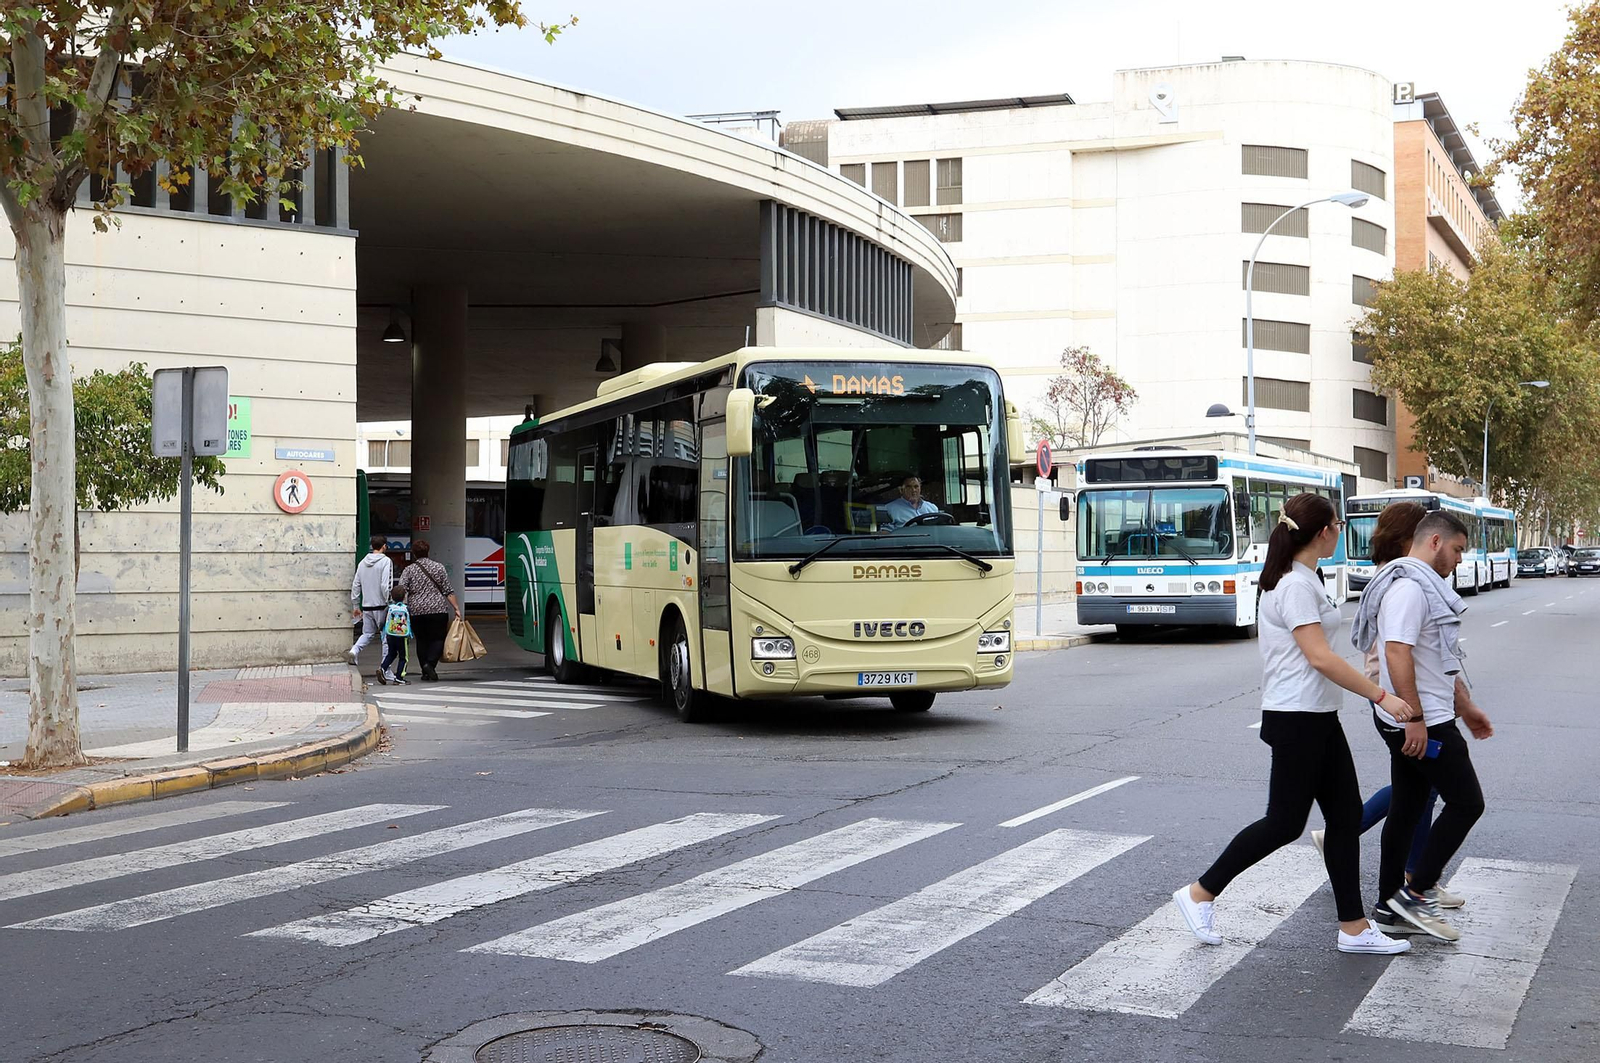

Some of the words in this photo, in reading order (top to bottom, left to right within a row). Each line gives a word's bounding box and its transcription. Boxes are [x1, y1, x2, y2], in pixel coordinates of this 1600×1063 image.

[832, 374, 904, 396] DAMAS
[286, 450, 325, 459] AUTOCARES
[853, 565, 922, 578] DAMAS
[853, 621, 926, 637] IVECO
[803, 650, 819, 659] 468
[864, 673, 891, 685] 3729
[893, 672, 914, 684] KGT
